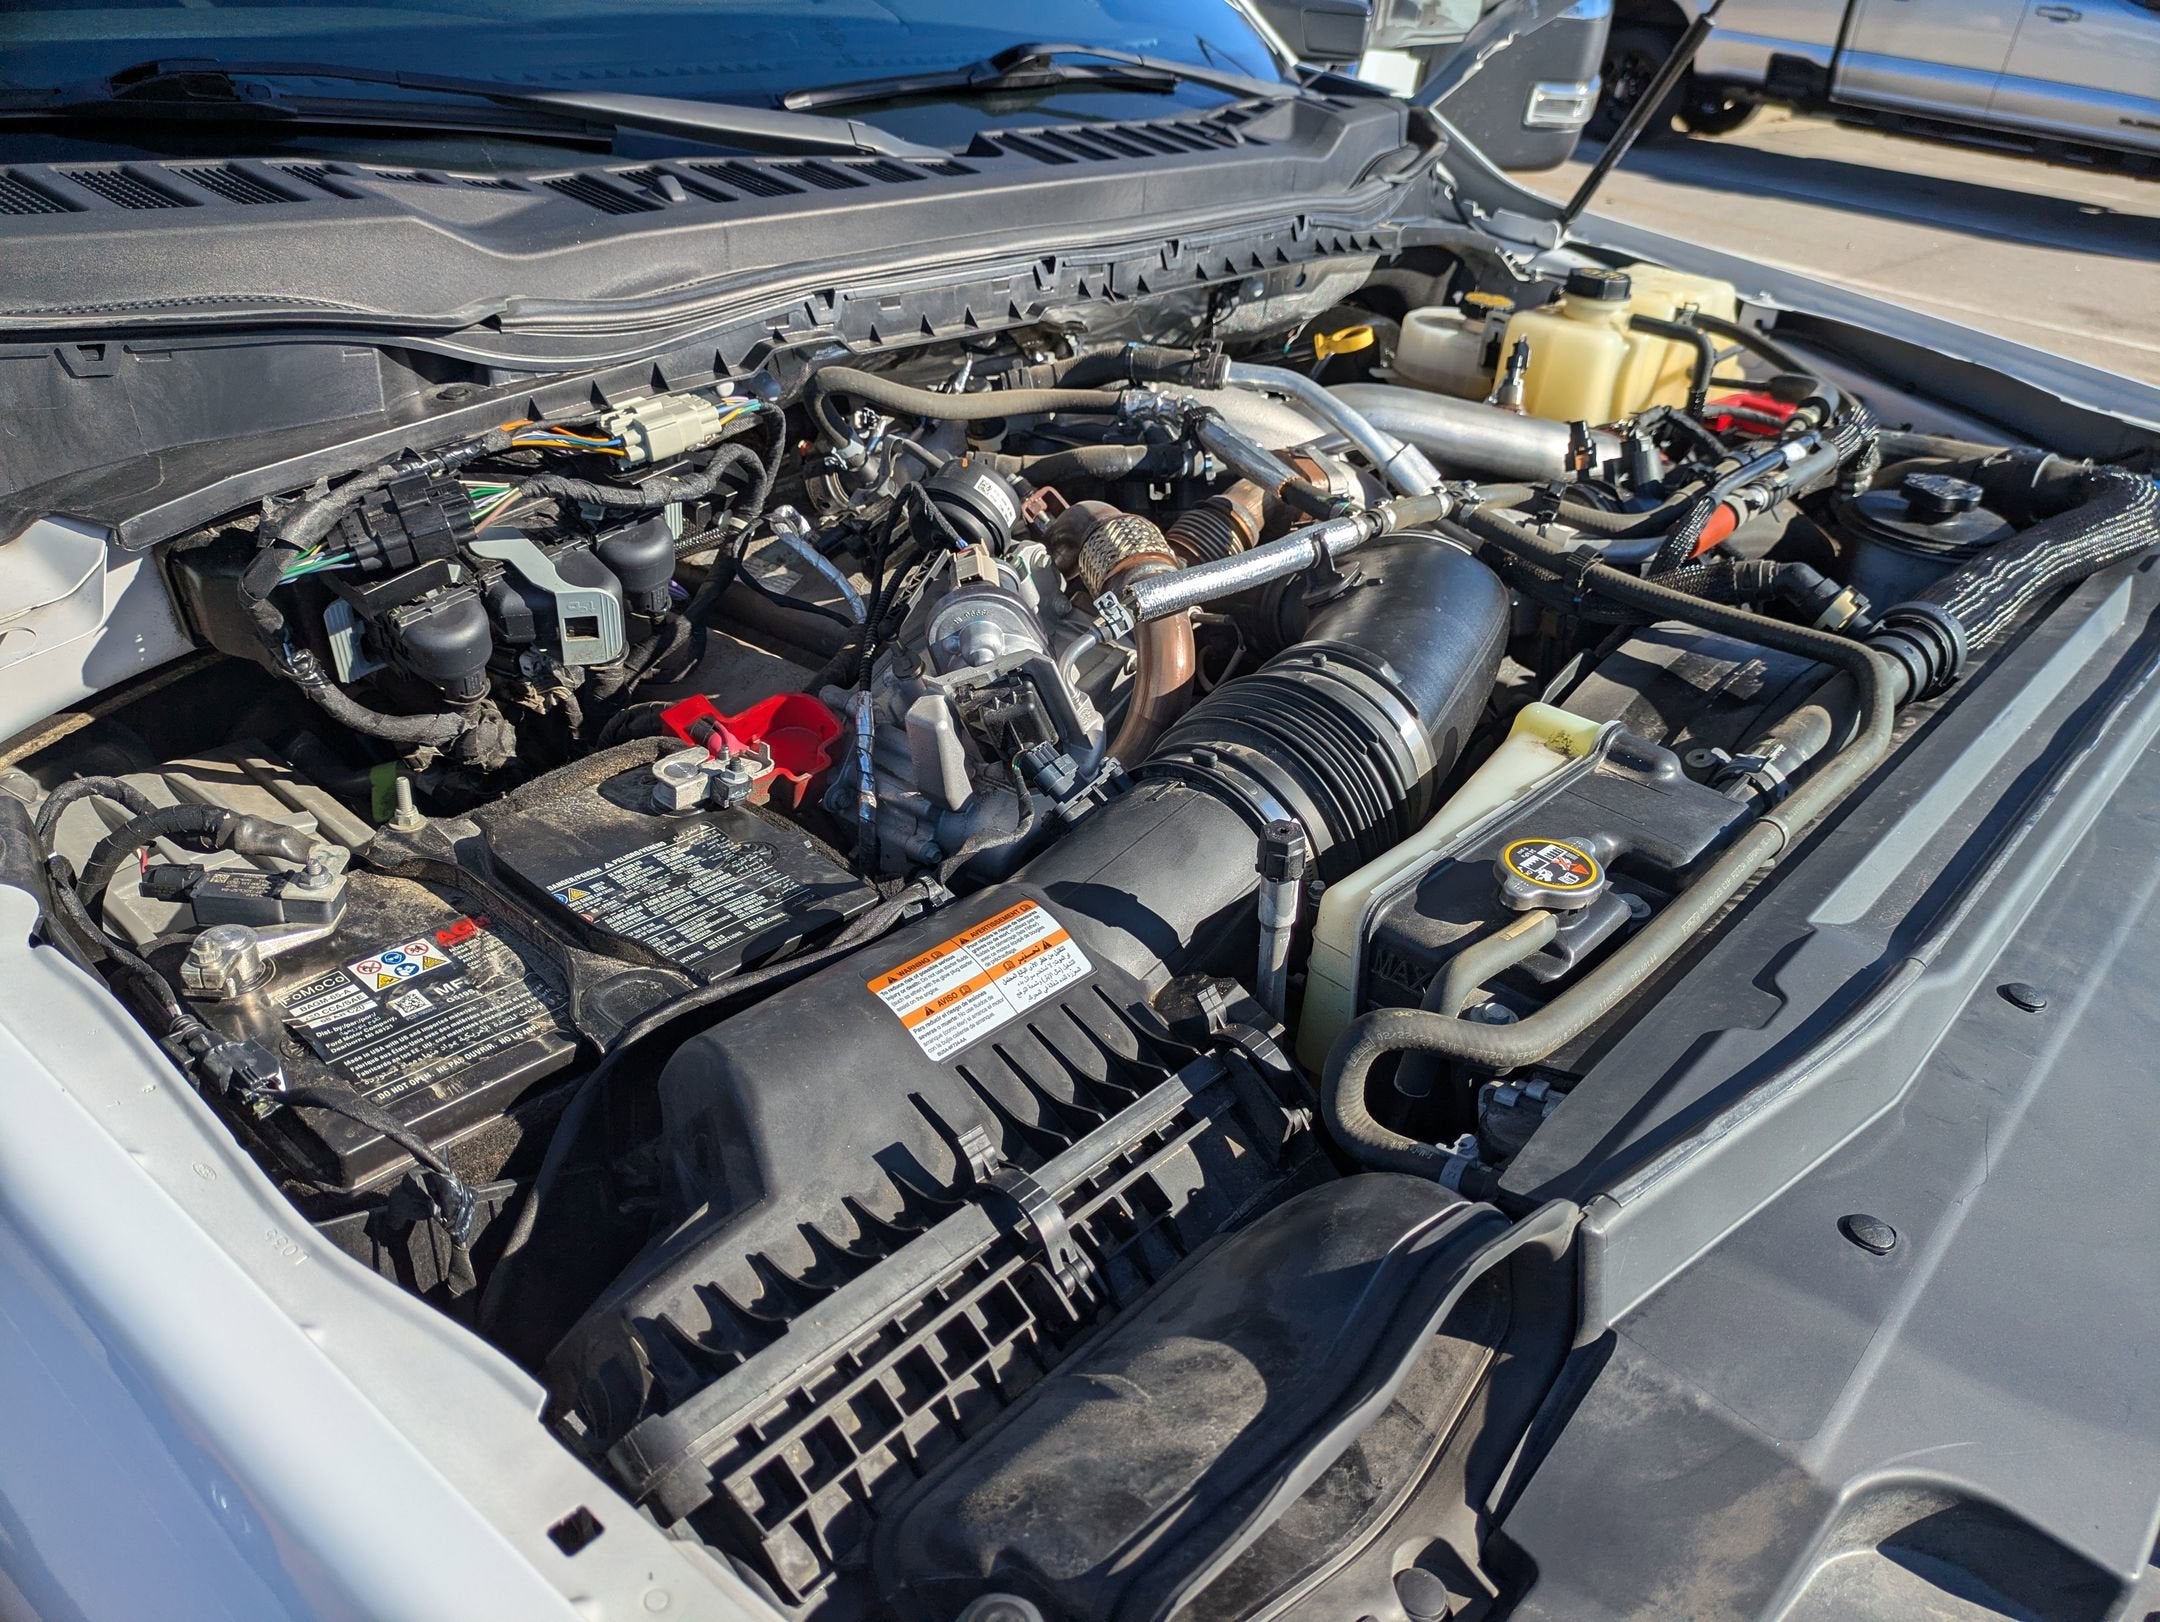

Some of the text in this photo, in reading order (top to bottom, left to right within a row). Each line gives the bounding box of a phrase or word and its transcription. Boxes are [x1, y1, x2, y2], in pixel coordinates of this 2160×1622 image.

[278, 974, 347, 1004] FoMoCo
[434, 978, 463, 996] MF
[324, 1015, 399, 1049] Ford Motor Company,
[342, 1054, 363, 1065] Made
[368, 1045, 385, 1054] USA
[382, 1038, 400, 1048] with
[397, 1034, 409, 1042] US
[407, 1029, 422, 1038] and
[419, 1017, 449, 1032] imported
[376, 1090, 392, 1099] DO
[389, 1081, 410, 1094] NOT
[434, 1063, 449, 1073] NE
[498, 1035, 511, 1044] NO
